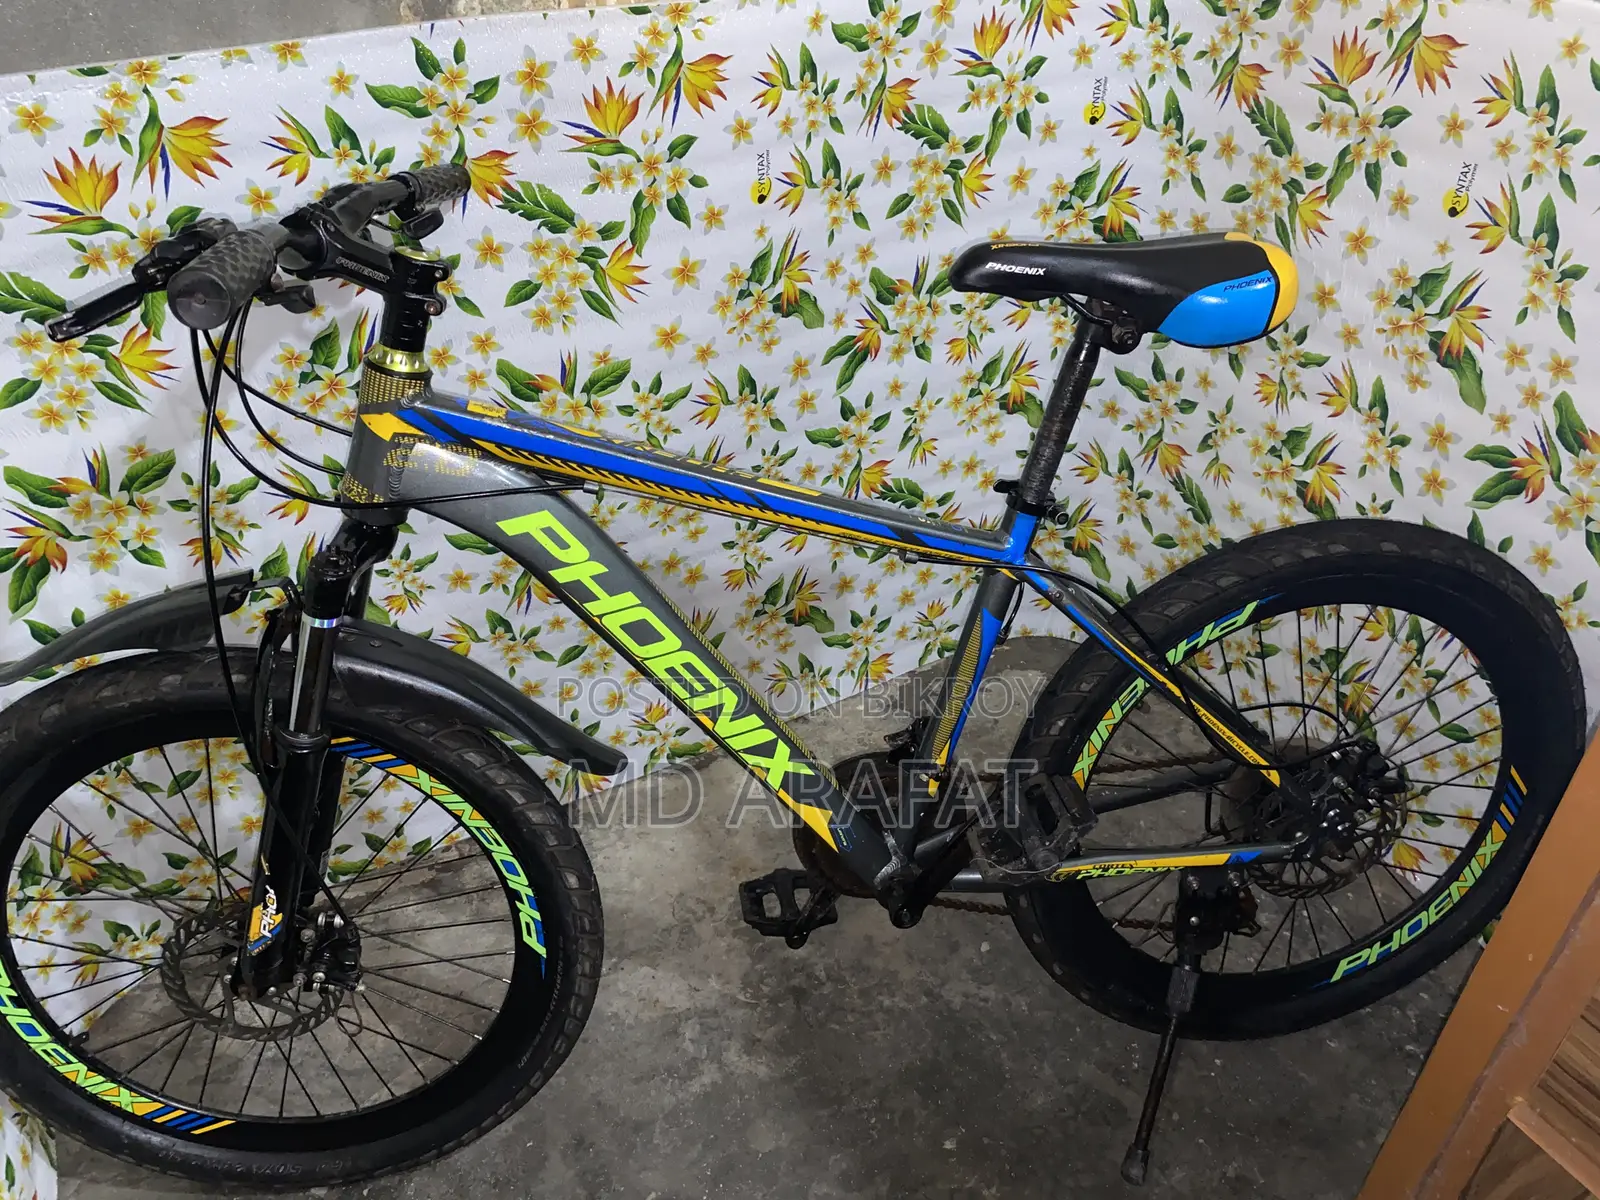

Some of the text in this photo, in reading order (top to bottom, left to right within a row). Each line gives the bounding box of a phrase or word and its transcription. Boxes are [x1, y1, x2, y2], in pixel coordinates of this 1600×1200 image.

[1091, 78, 1103, 115] SYNTAX
[757, 153, 765, 193] SYNTAX
[1452, 161, 1472, 207] SYNTAX
[985, 261, 1046, 275] PHOENIX
[1223, 276, 1273, 292] PHOENIX
[495, 509, 815, 792] PHOENIX
[398, 767, 547, 959] PHOENIX
[1329, 828, 1505, 984] PHOENIX
